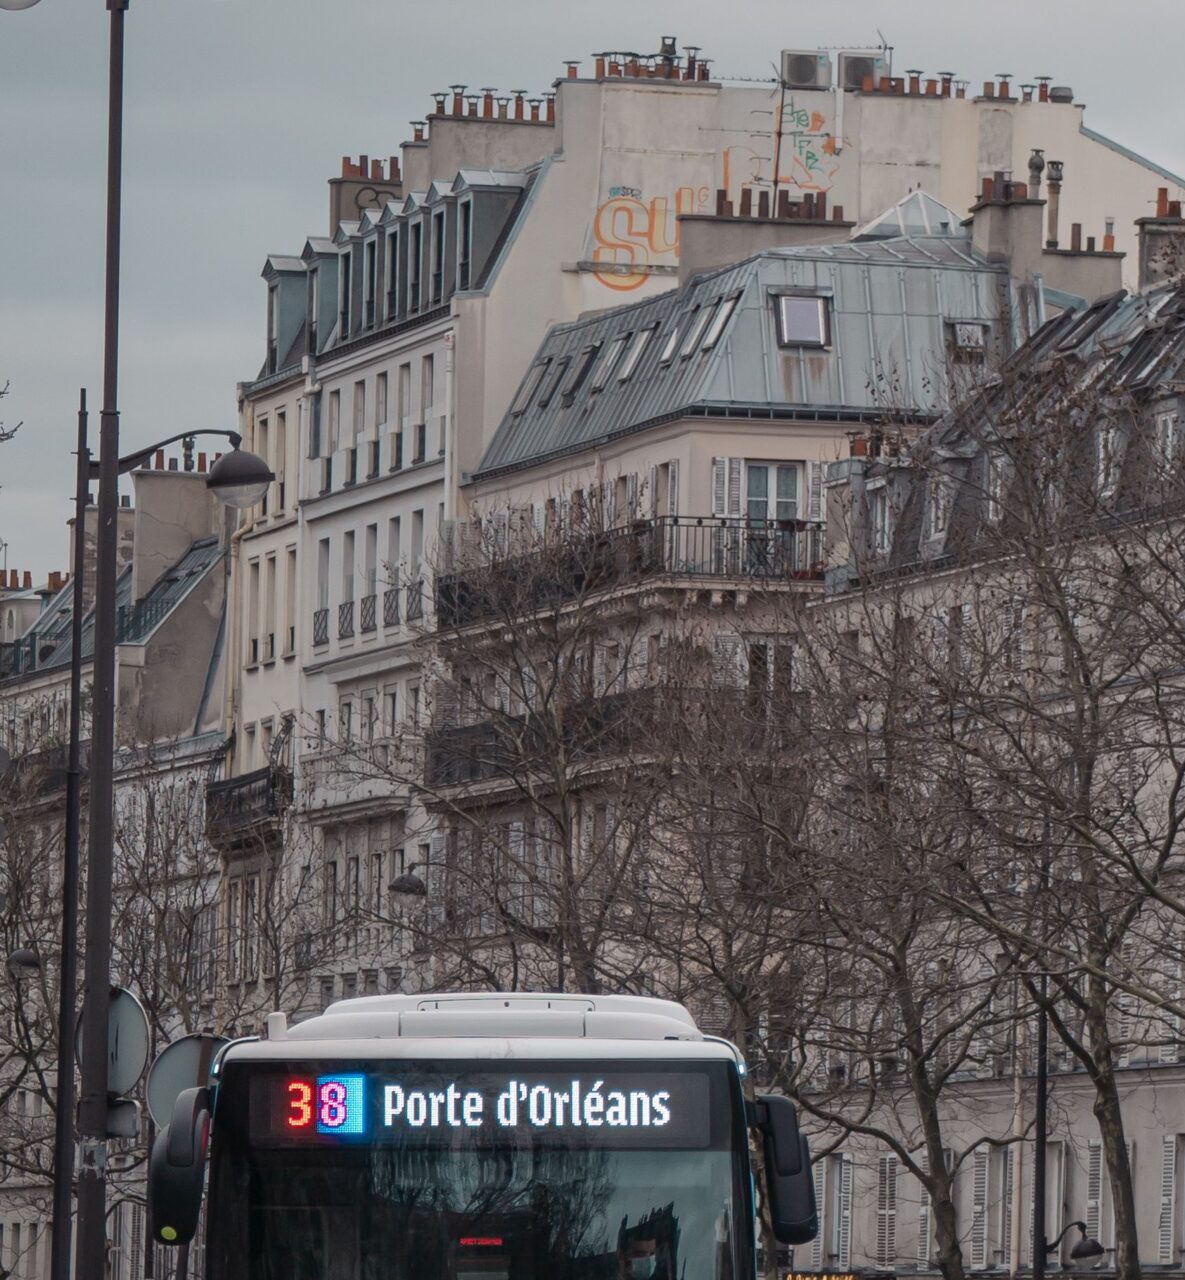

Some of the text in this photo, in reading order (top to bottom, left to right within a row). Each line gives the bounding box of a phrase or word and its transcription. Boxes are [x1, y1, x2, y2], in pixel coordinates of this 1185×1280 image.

[288, 1080, 671, 1127] 38 Porte d'Orléans
